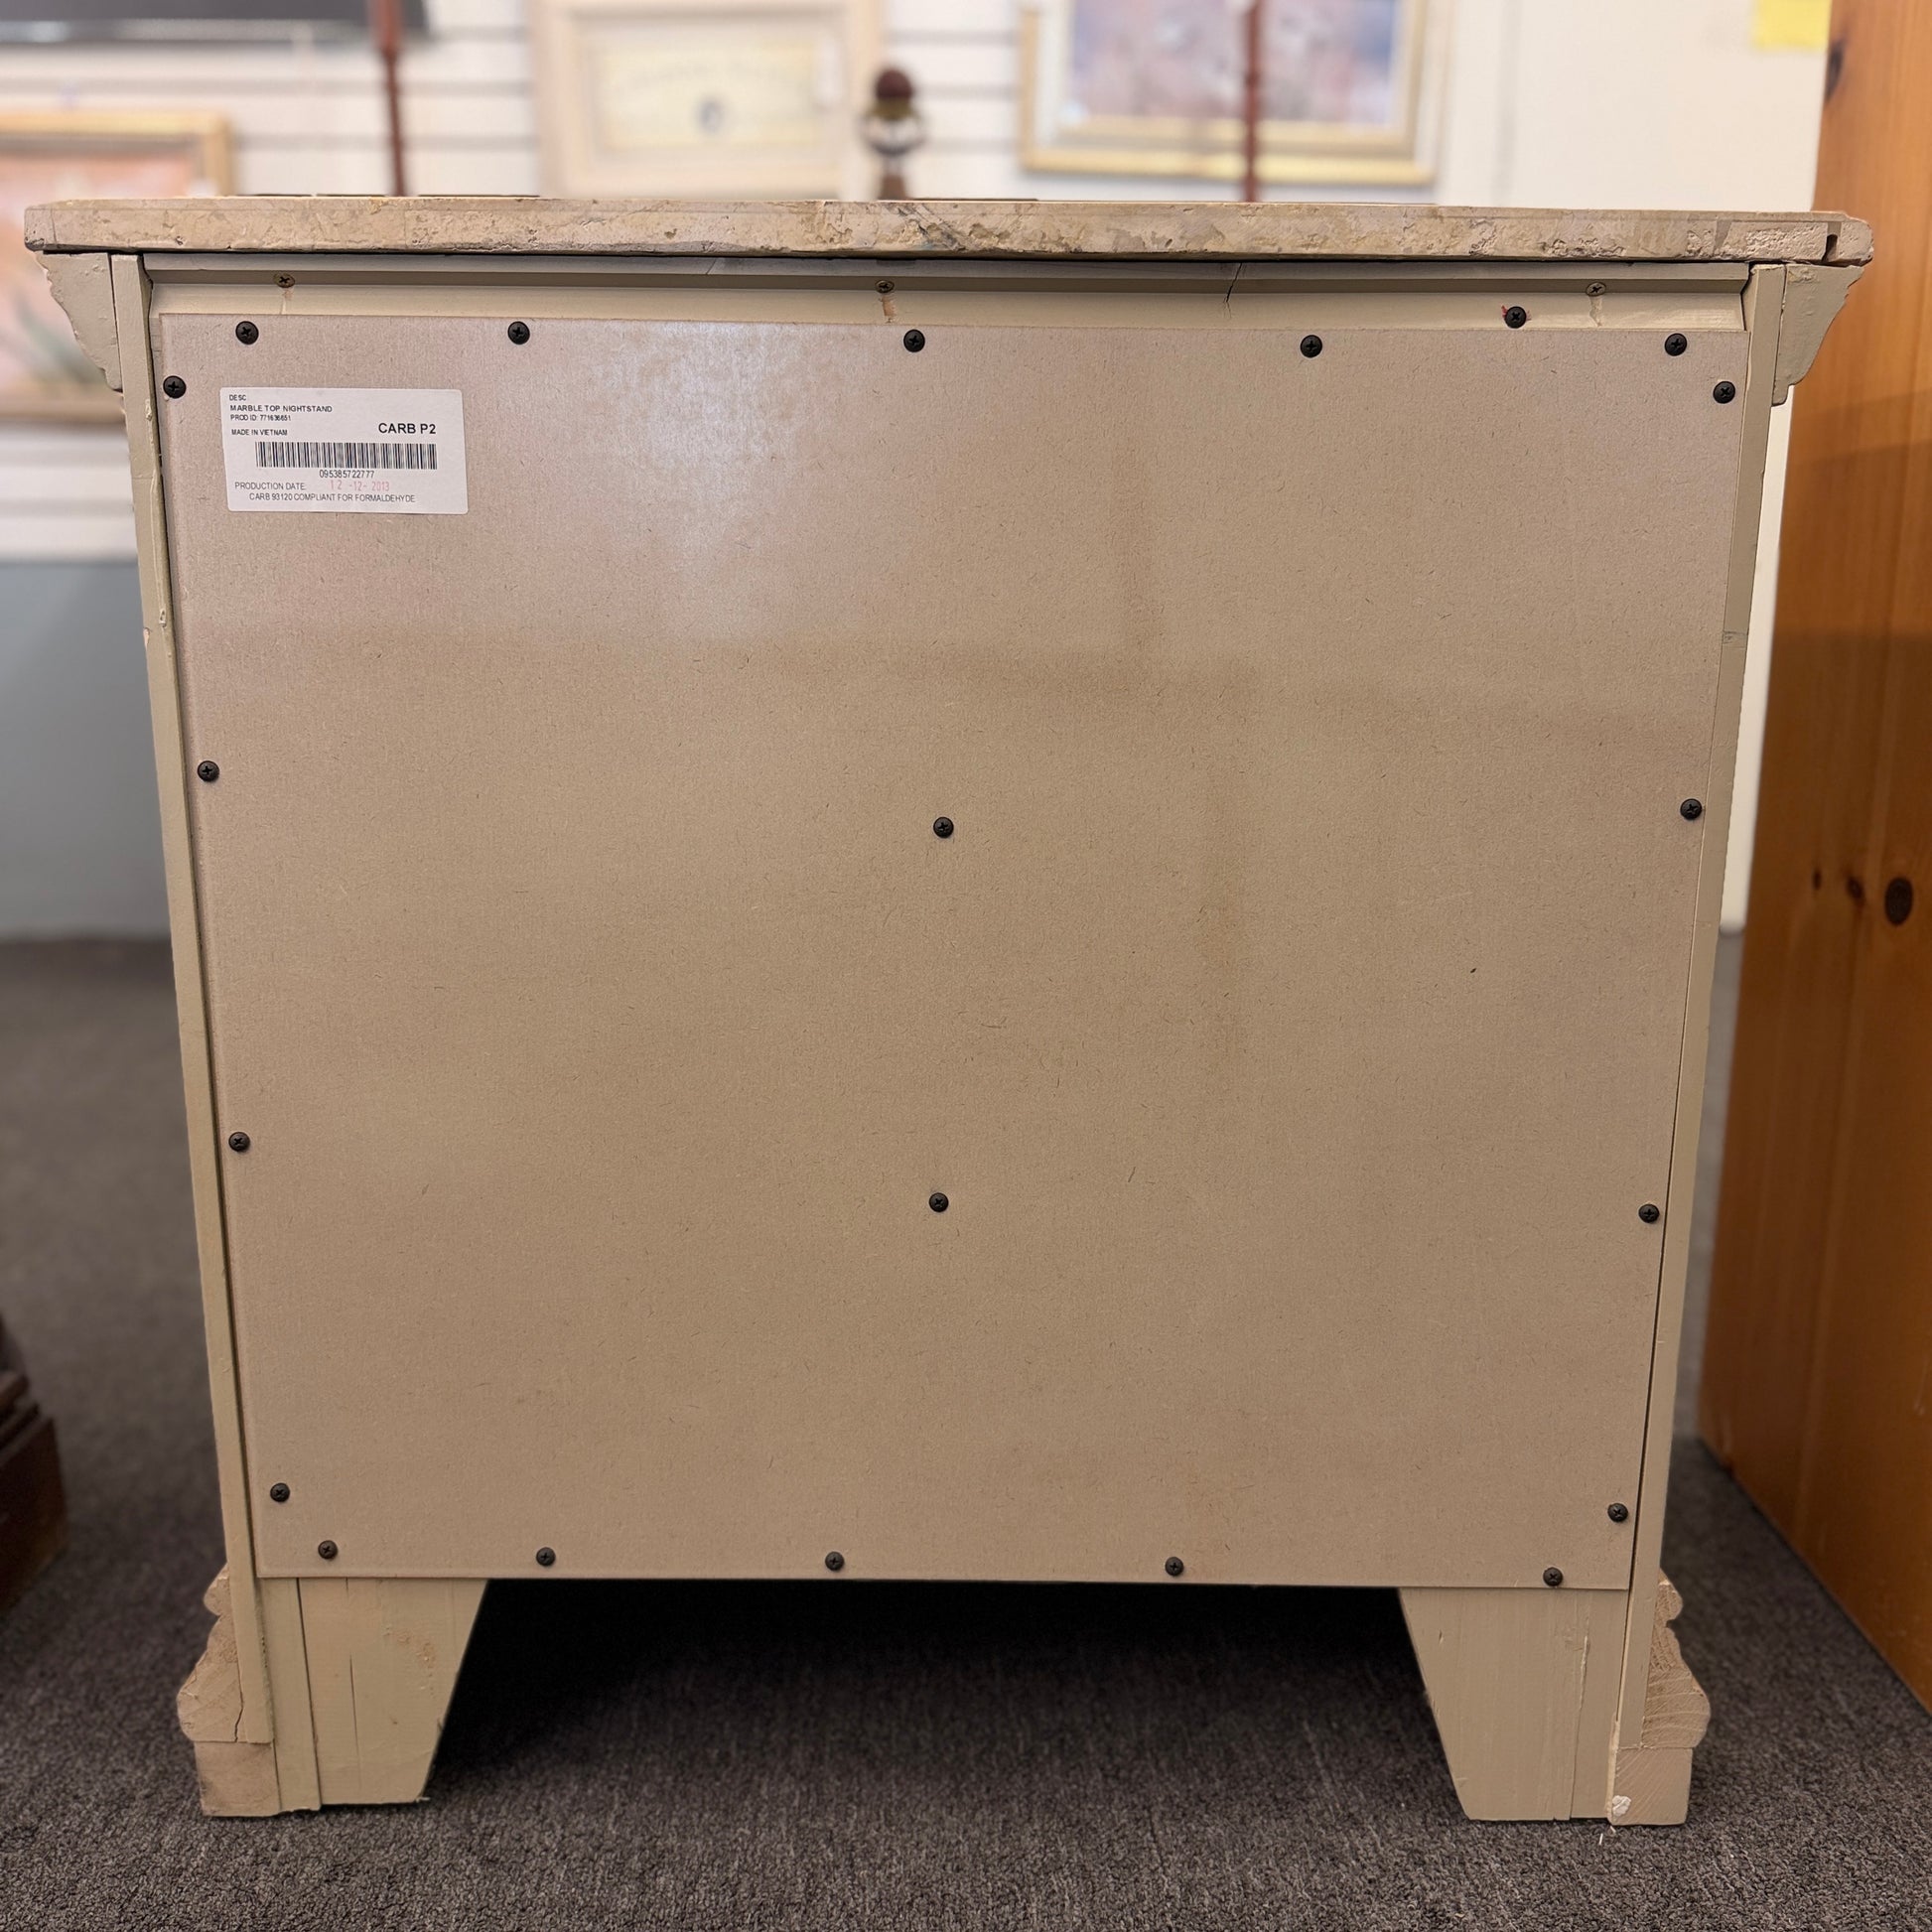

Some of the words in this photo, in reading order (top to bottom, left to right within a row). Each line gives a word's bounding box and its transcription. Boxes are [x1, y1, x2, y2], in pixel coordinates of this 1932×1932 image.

[378, 422, 417, 434] CARB
[420, 423, 437, 435] P2
[319, 470, 375, 479] 095385722777
[234, 482, 284, 490] PRODUCTION
